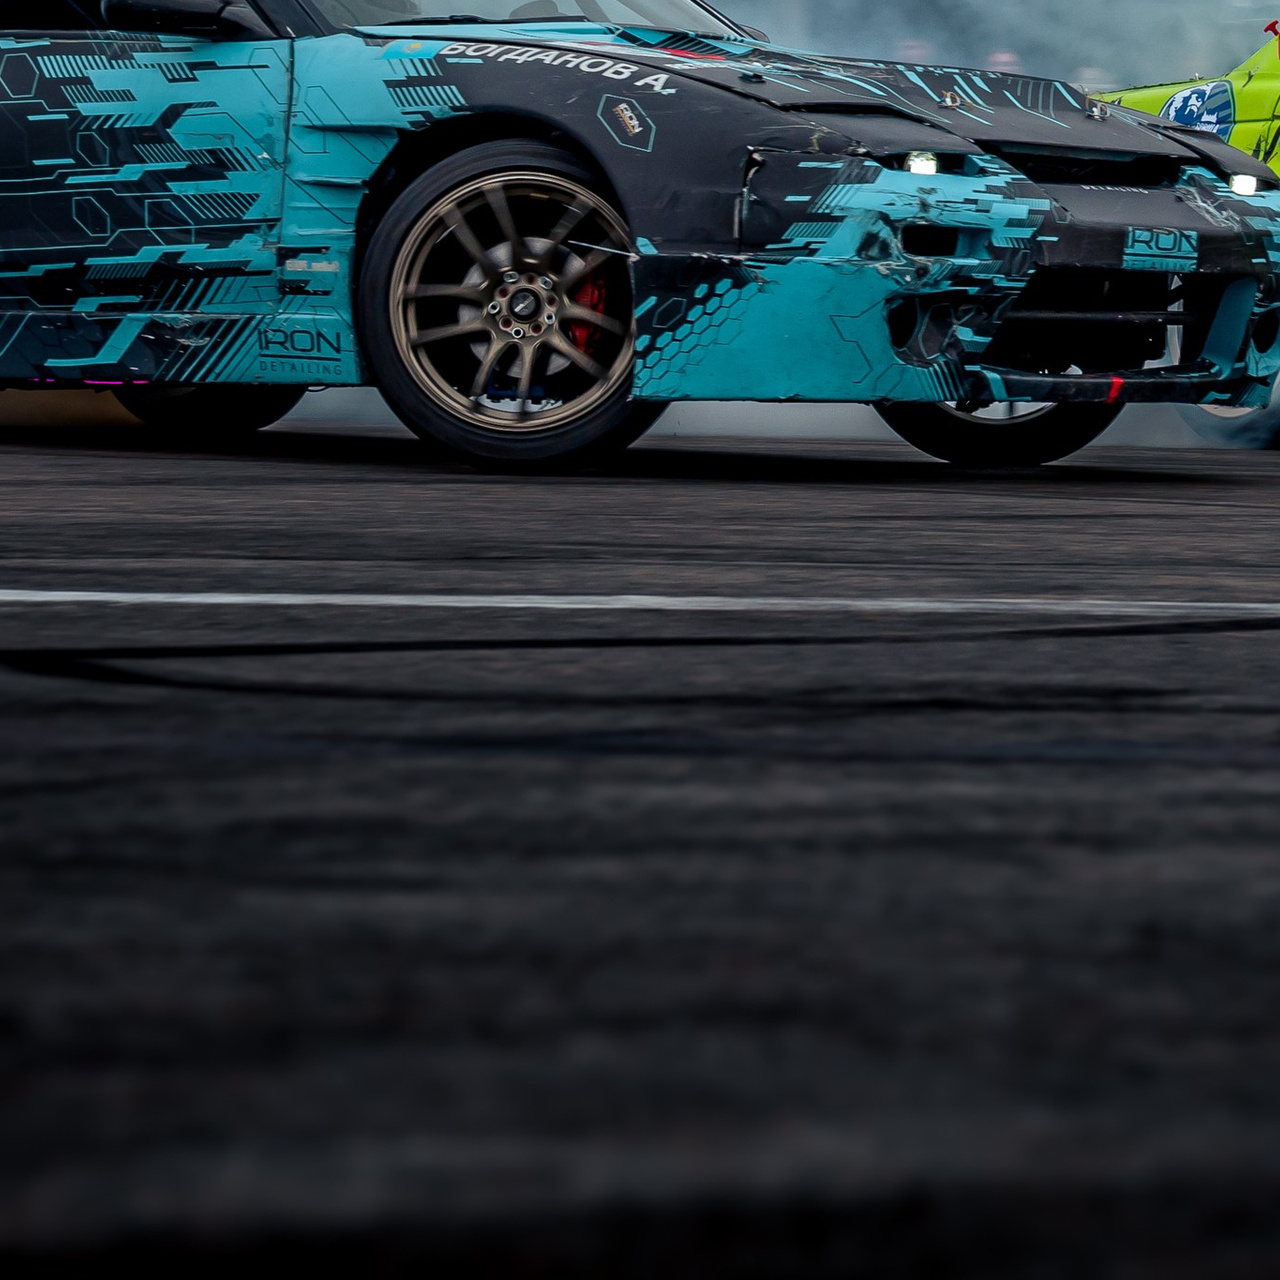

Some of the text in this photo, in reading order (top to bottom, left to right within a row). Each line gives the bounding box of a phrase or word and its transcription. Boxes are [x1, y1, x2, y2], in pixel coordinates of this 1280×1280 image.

[440, 42, 639, 80] БОГДАНОВ
[258, 328, 341, 354] IRON
[259, 361, 342, 376] DETAILING
